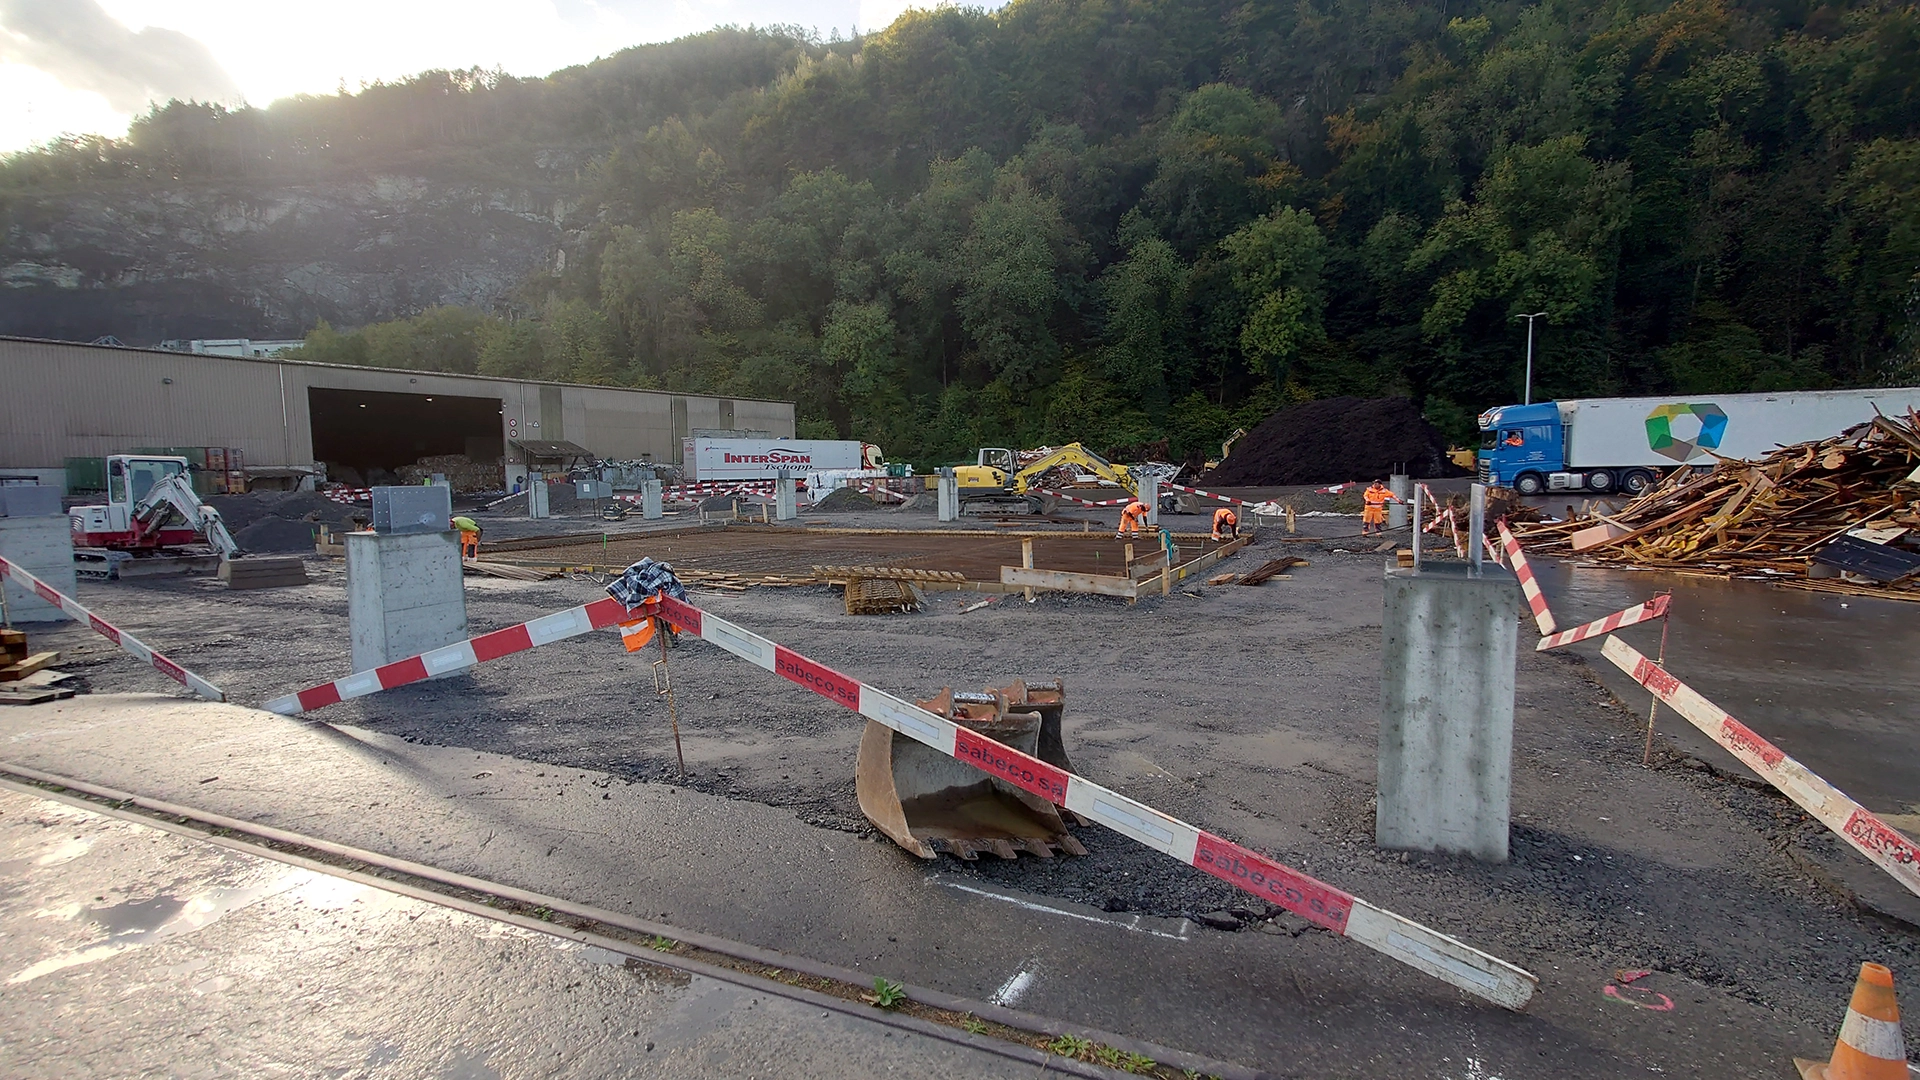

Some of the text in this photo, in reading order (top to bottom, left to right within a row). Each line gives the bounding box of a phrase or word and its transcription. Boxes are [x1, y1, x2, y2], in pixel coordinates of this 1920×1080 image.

[724, 452, 811, 464] INTERSPAN
[777, 658, 857, 703] sabeco sa
[958, 741, 1063, 796] sabeco sa
[1199, 848, 1344, 922] sabeco sa
